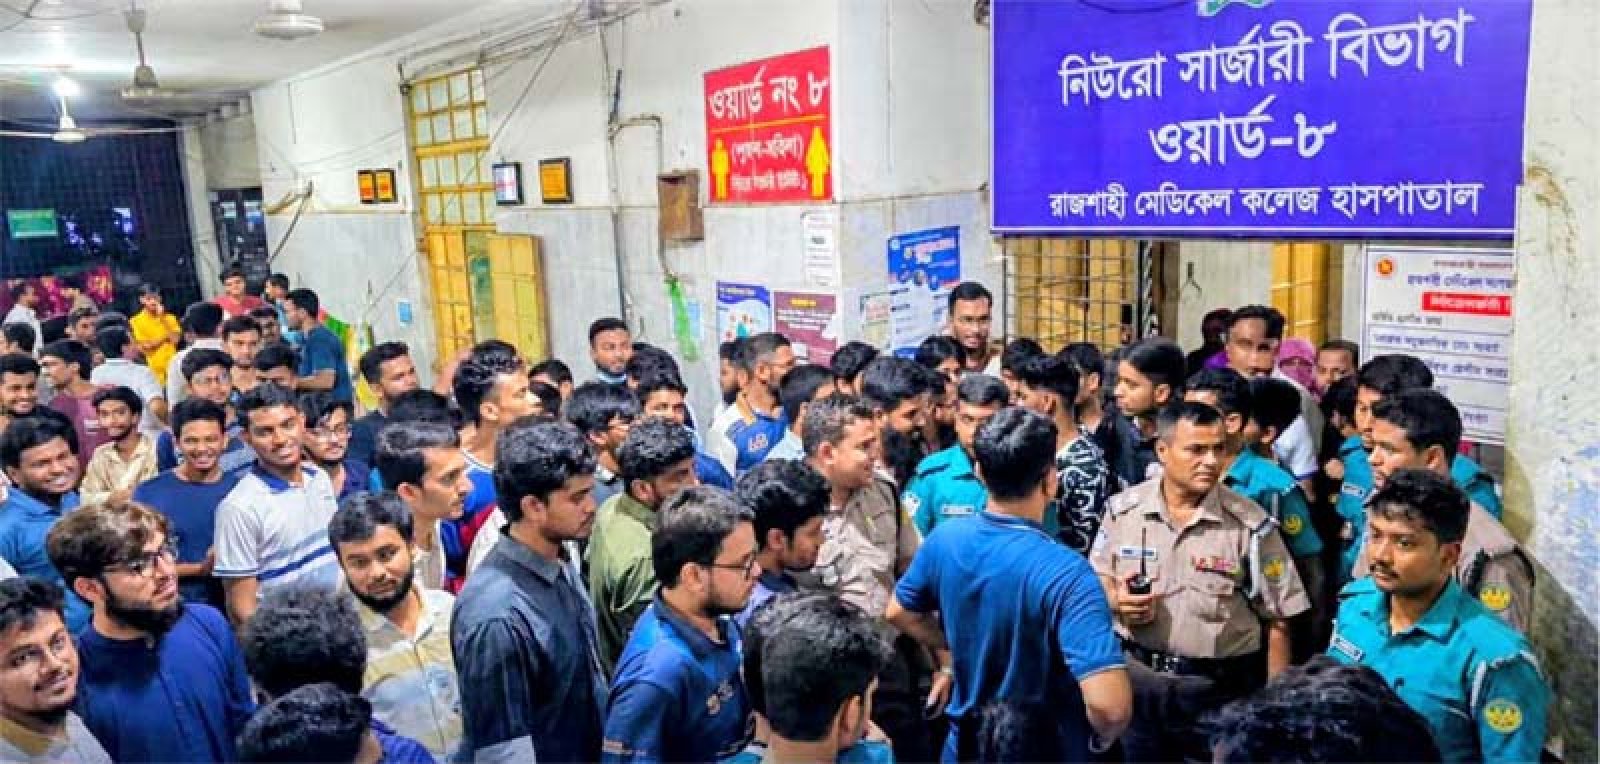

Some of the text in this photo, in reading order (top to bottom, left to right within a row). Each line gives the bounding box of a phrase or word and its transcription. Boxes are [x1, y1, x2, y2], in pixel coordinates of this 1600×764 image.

[1058, 8, 1475, 106] নিউরো সার্জারী বিভাগ
[710, 64, 829, 119] ওয়ার্ড নং ৮
[1049, 181, 1484, 219] রাজশাহী মেডিকেল কলেজ হাসপাতাল
